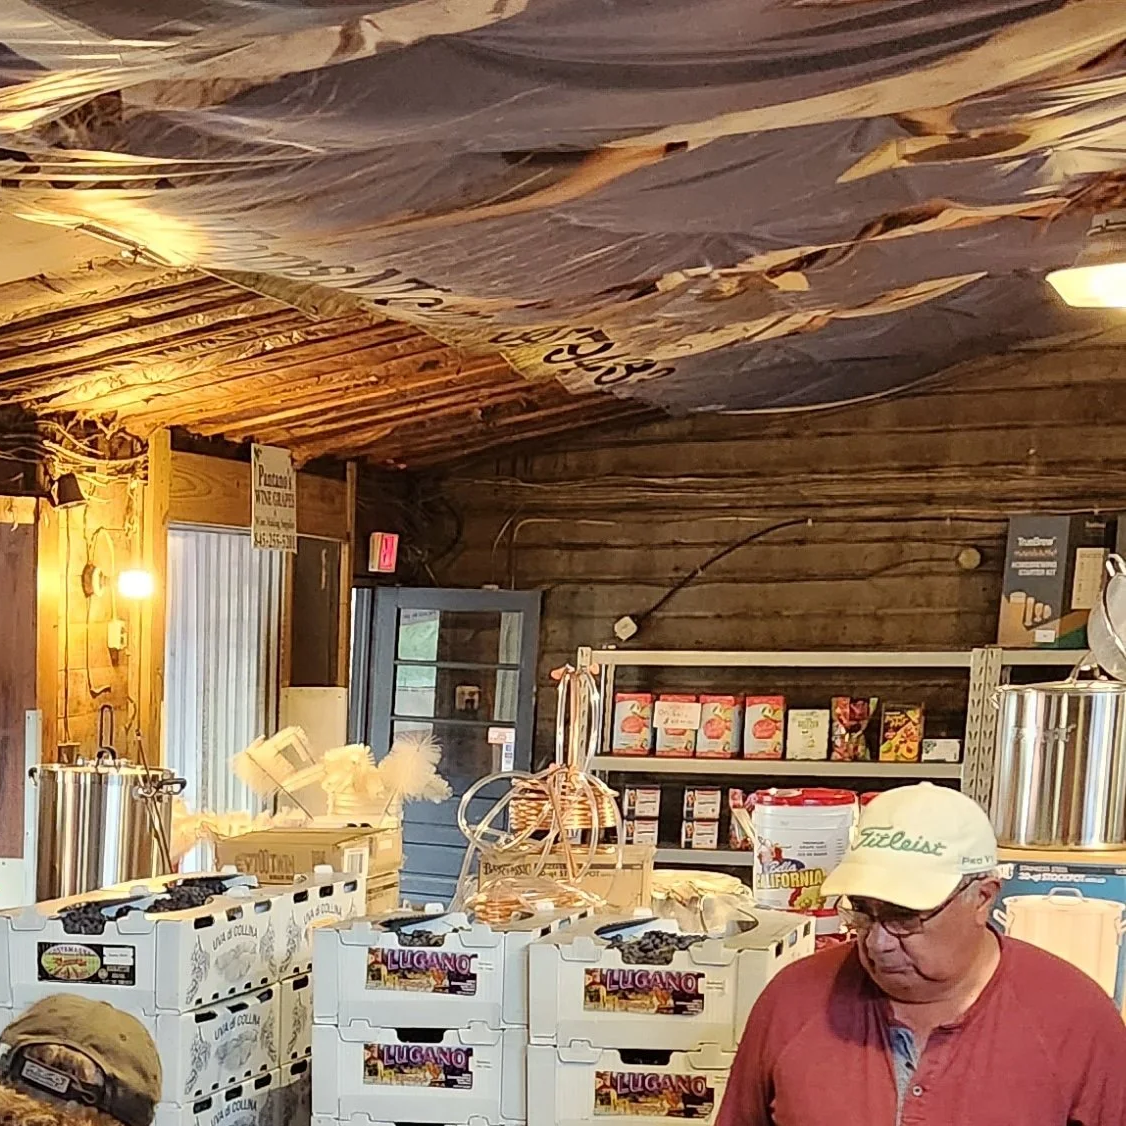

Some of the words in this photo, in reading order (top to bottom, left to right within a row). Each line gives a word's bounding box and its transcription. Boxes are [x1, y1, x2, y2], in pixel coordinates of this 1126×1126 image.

[850, 825, 947, 856] Titleist
[756, 868, 824, 889] CALIFORNIA
[212, 932, 226, 951] UVA
[233, 924, 258, 938] COLLINA
[386, 948, 470, 974] LUGANO
[605, 969, 697, 994] LUGANO
[214, 1022, 229, 1040] UVA
[236, 1015, 260, 1027] COLLINA
[383, 1045, 466, 1068] LUGANO
[616, 1072, 706, 1096] LUGANO
[232, 1099, 257, 1112] COLLINA
